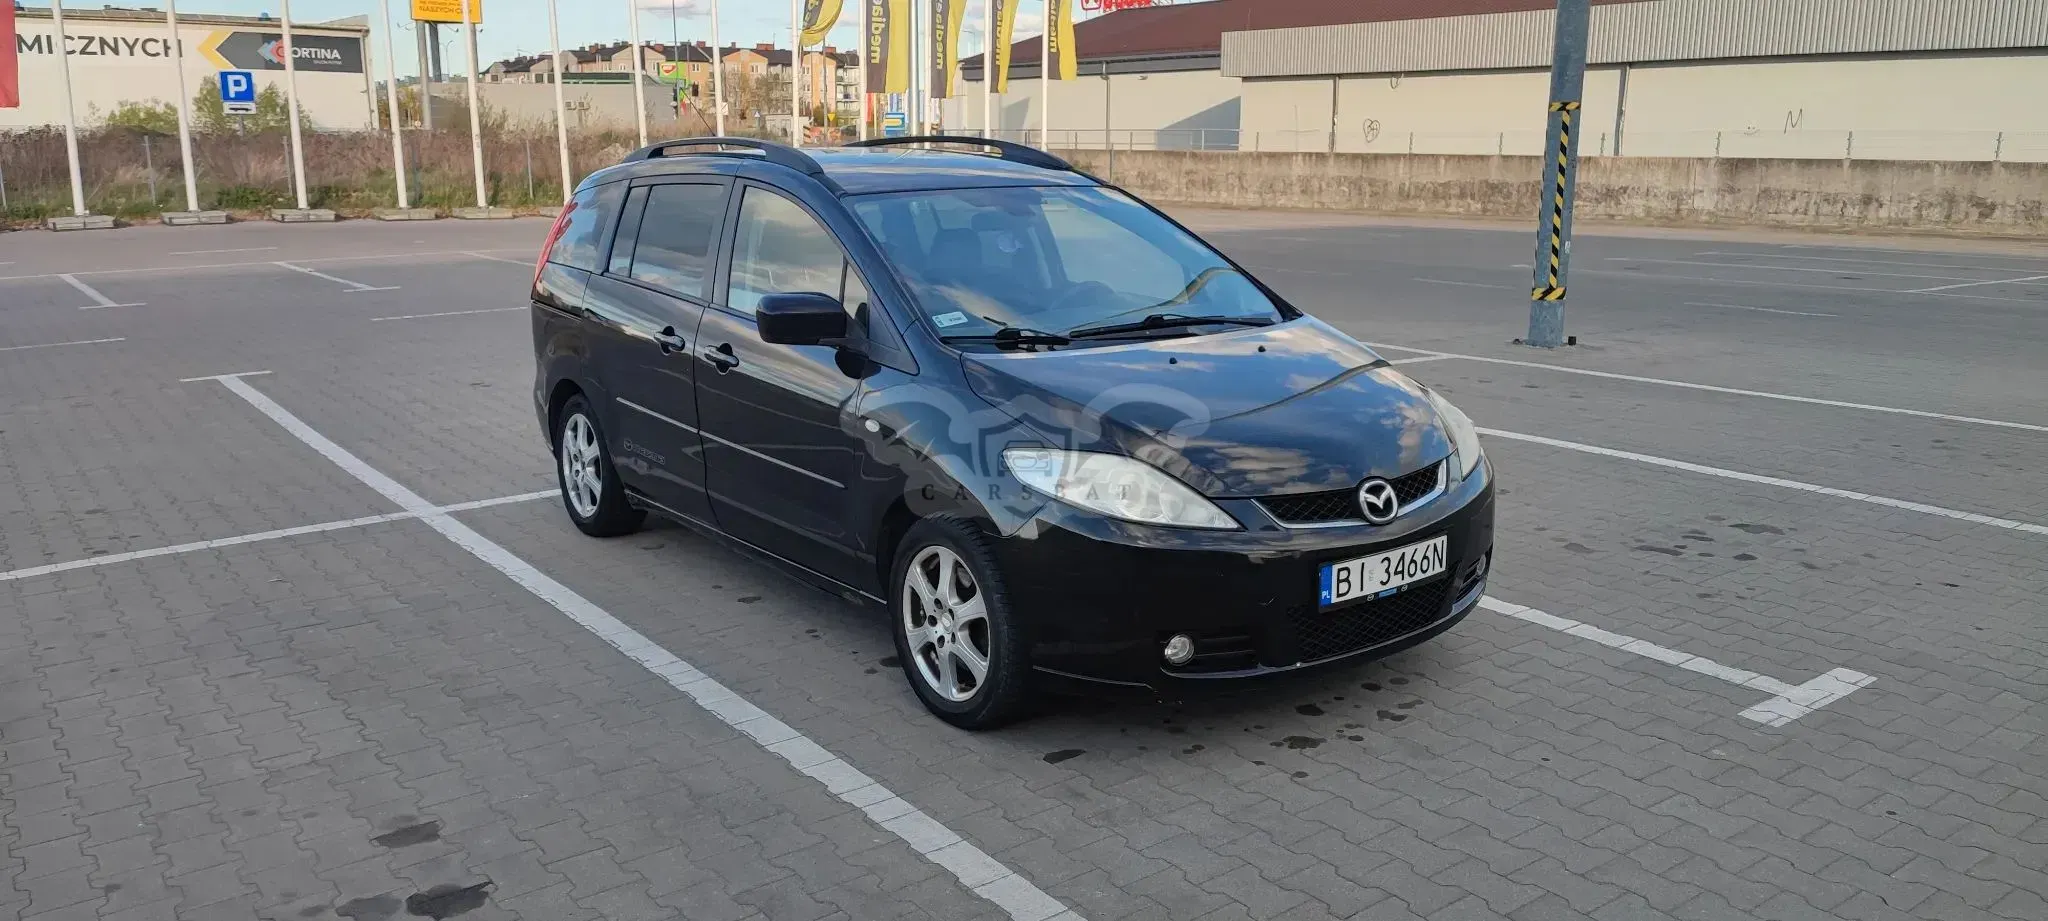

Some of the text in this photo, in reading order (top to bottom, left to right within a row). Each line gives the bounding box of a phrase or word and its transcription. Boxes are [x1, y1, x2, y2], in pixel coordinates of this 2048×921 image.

[226, 75, 248, 98] P
[1336, 540, 1445, 598] BI 3466N
[1321, 590, 1331, 600] PL
